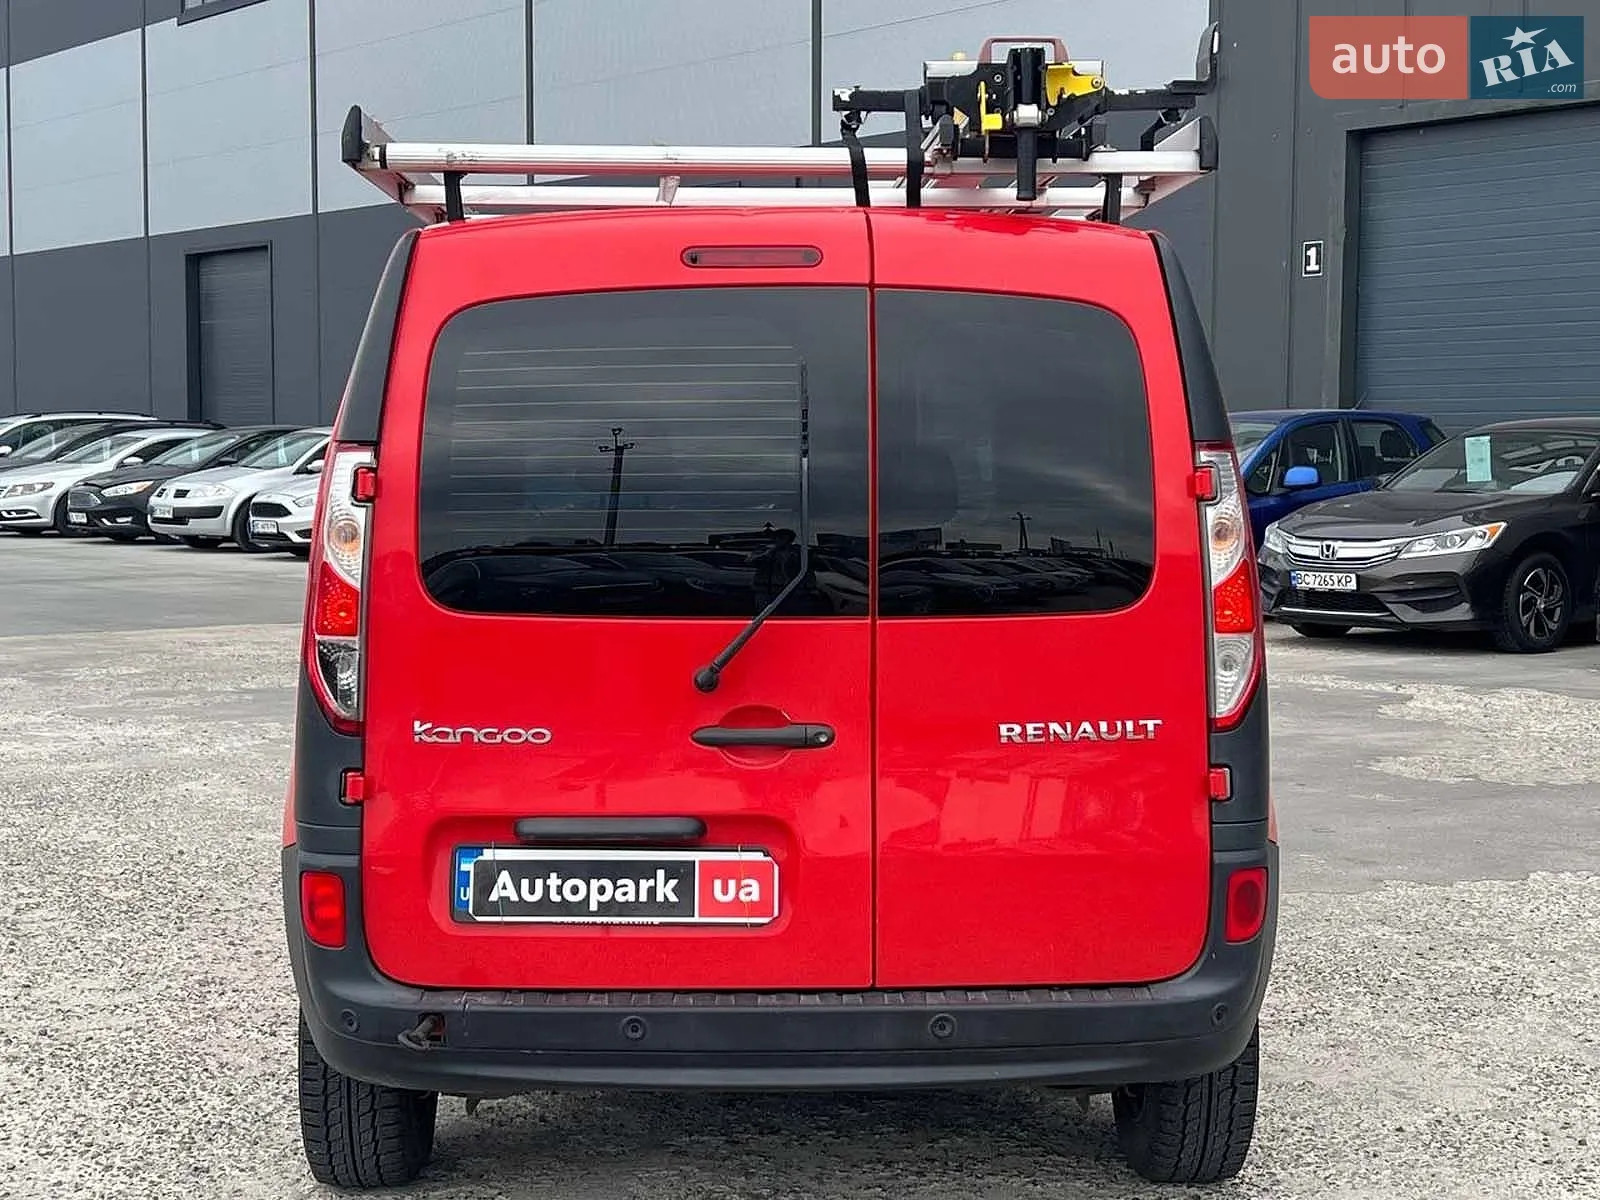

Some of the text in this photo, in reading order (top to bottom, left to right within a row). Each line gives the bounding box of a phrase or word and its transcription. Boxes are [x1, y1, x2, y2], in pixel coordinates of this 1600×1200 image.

[1305, 246, 1320, 271] 1
[1296, 573, 1353, 587] BC 7265 KP
[998, 719, 1163, 744] RENAULT
[488, 869, 762, 911] Autopark ua
